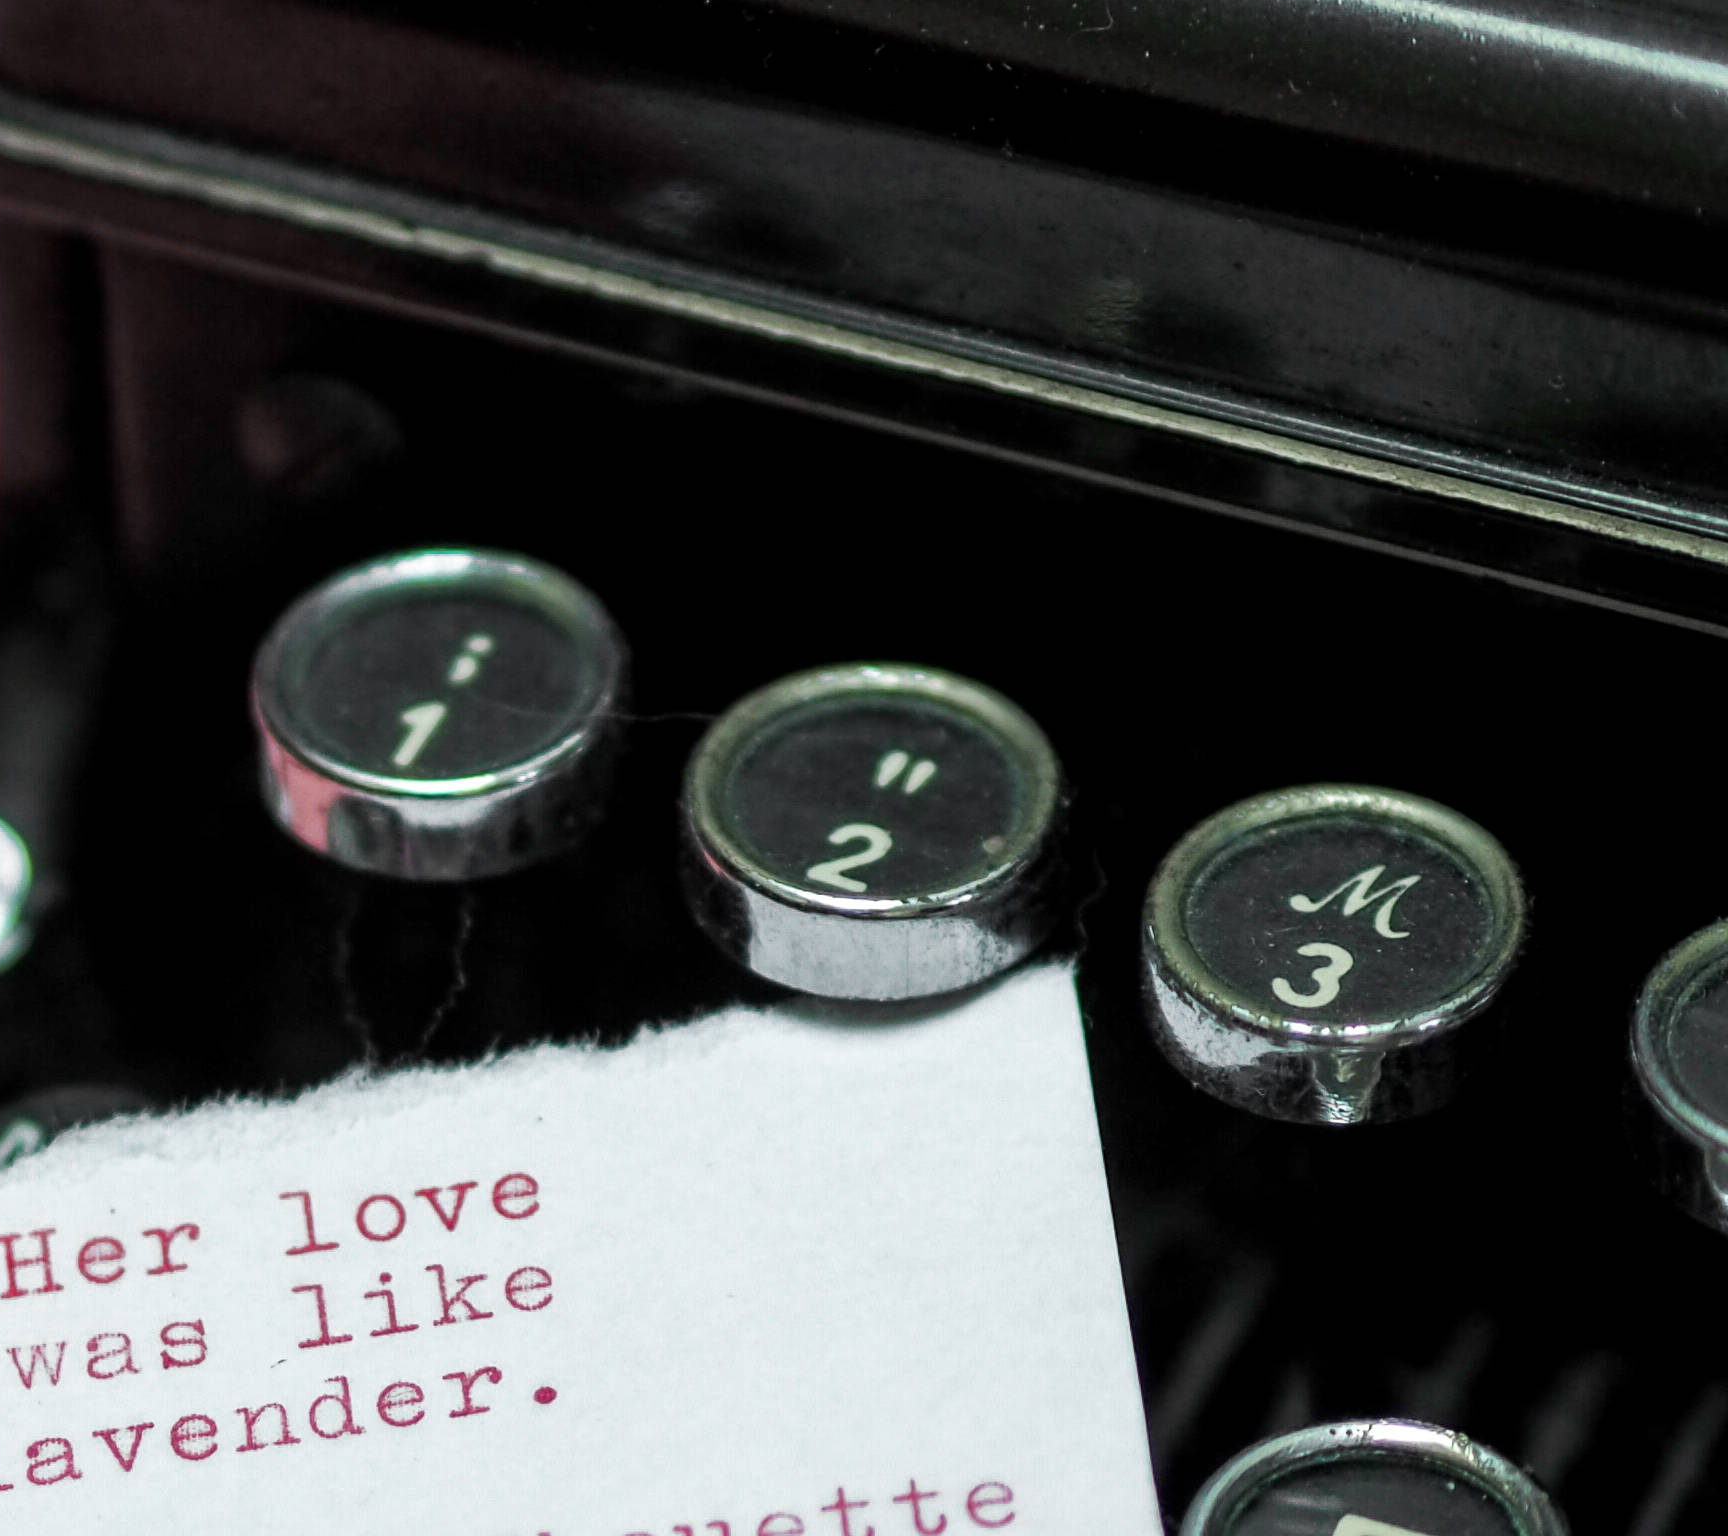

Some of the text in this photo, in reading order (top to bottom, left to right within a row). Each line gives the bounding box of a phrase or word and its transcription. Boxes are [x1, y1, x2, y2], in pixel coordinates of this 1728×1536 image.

[392, 702, 447, 768] 1
[806, 822, 892, 893] 2
[1270, 941, 1354, 1010] 3
[279, 1171, 541, 1257] love
[6, 1262, 554, 1390] was like
